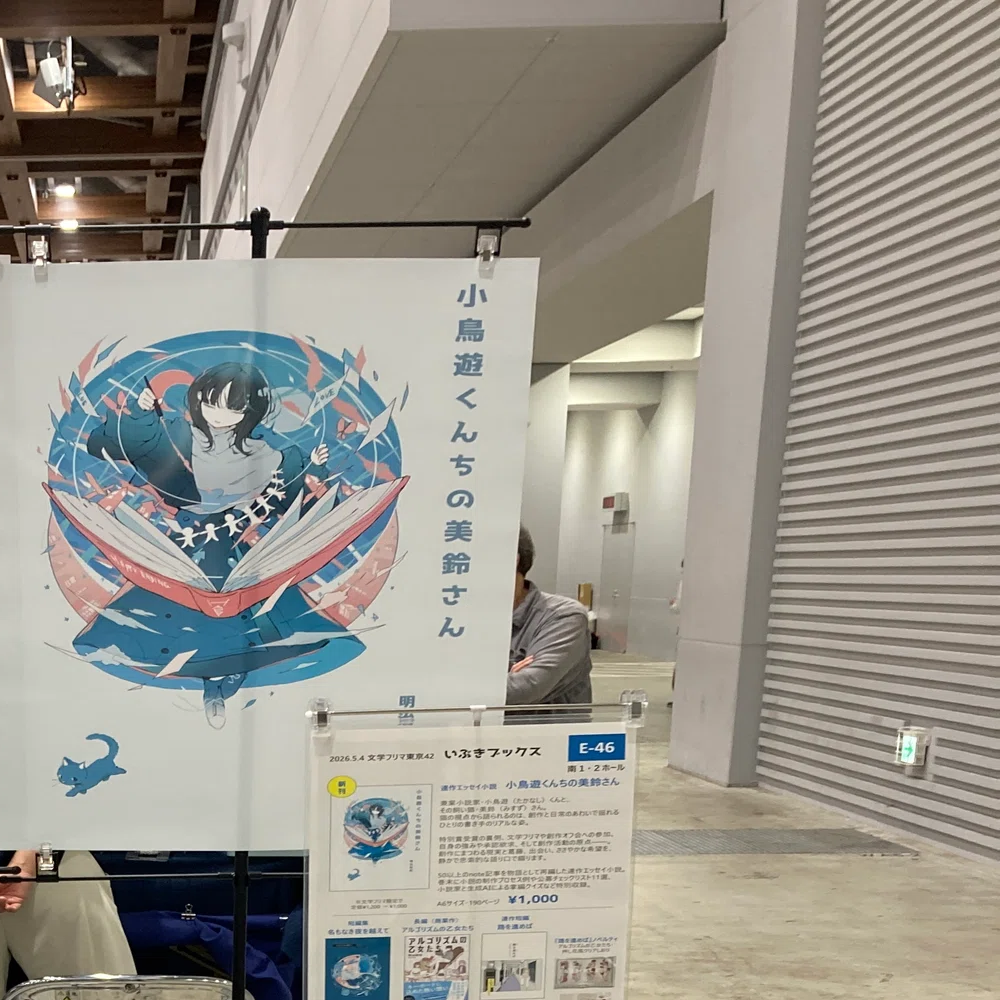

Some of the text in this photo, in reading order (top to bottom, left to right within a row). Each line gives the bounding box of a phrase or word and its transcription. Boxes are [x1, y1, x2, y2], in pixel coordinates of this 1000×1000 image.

[438, 283, 488, 638] 小鳥遊くんちの美鈴さん
[444, 746, 542, 759] いぶきブックス
[578, 742, 616, 754] E-46
[329, 752, 435, 763] 2026.5.4 文学フリマ東京42
[440, 777, 620, 792] 連作エッセイ小説 小鳥遊くんちの美鈴さん
[508, 894, 559, 905] ¥1,000
